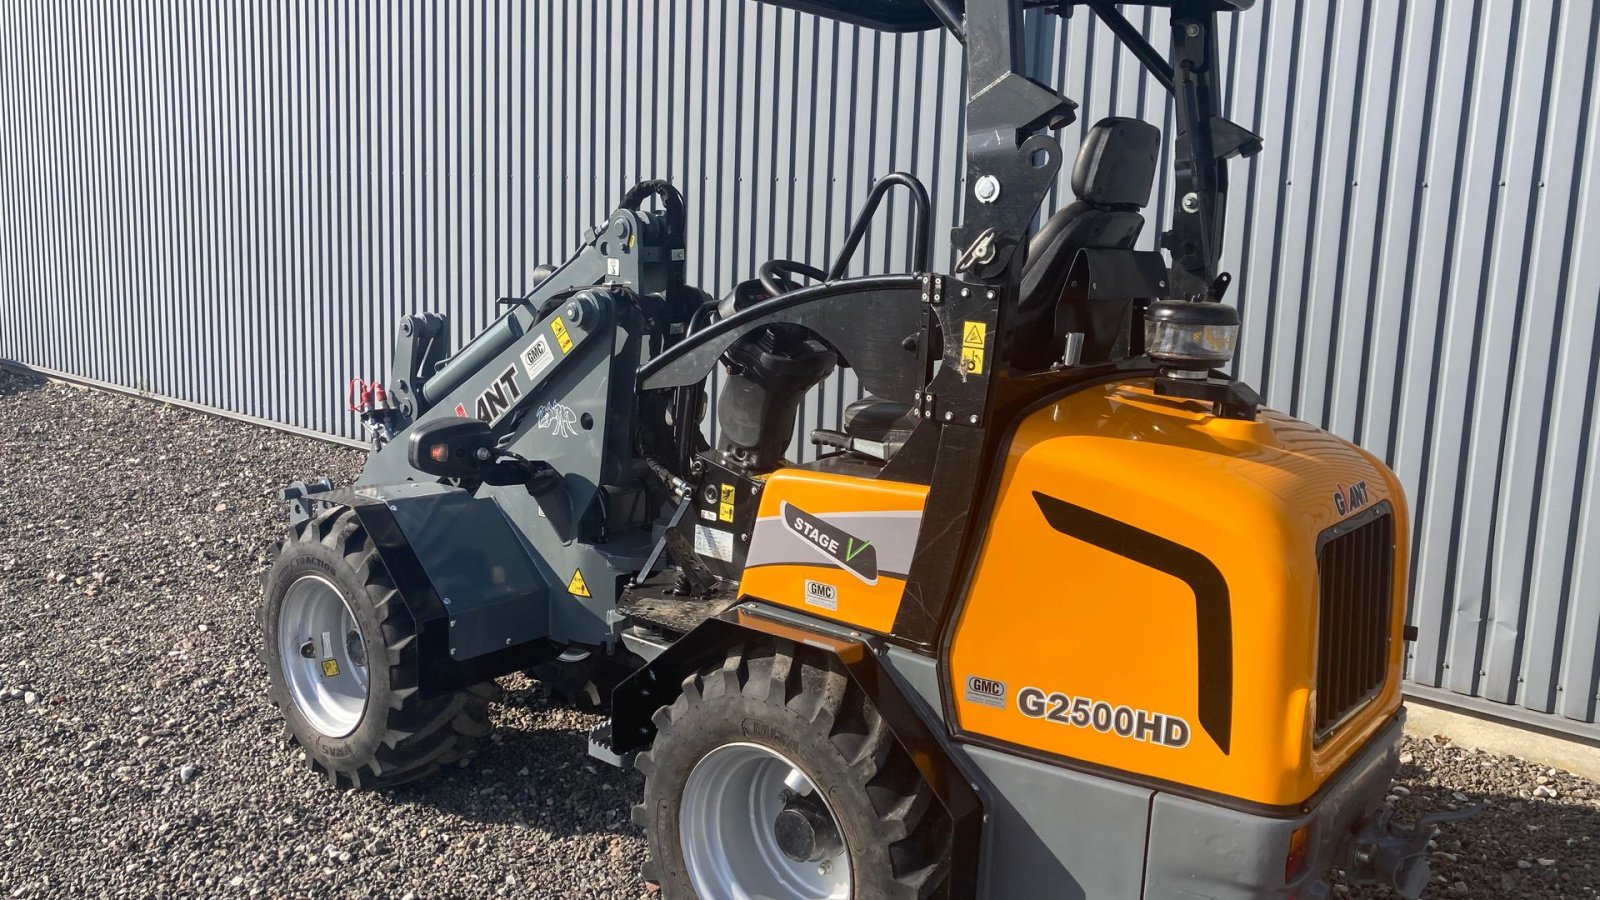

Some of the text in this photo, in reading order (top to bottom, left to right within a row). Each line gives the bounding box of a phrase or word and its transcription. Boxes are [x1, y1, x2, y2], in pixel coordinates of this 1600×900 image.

[527, 343, 544, 364] GMC
[794, 517, 871, 562] STAGE V
[811, 583, 832, 598] GMC
[974, 679, 1000, 695] GMC
[1017, 686, 1191, 749] G2500HD
